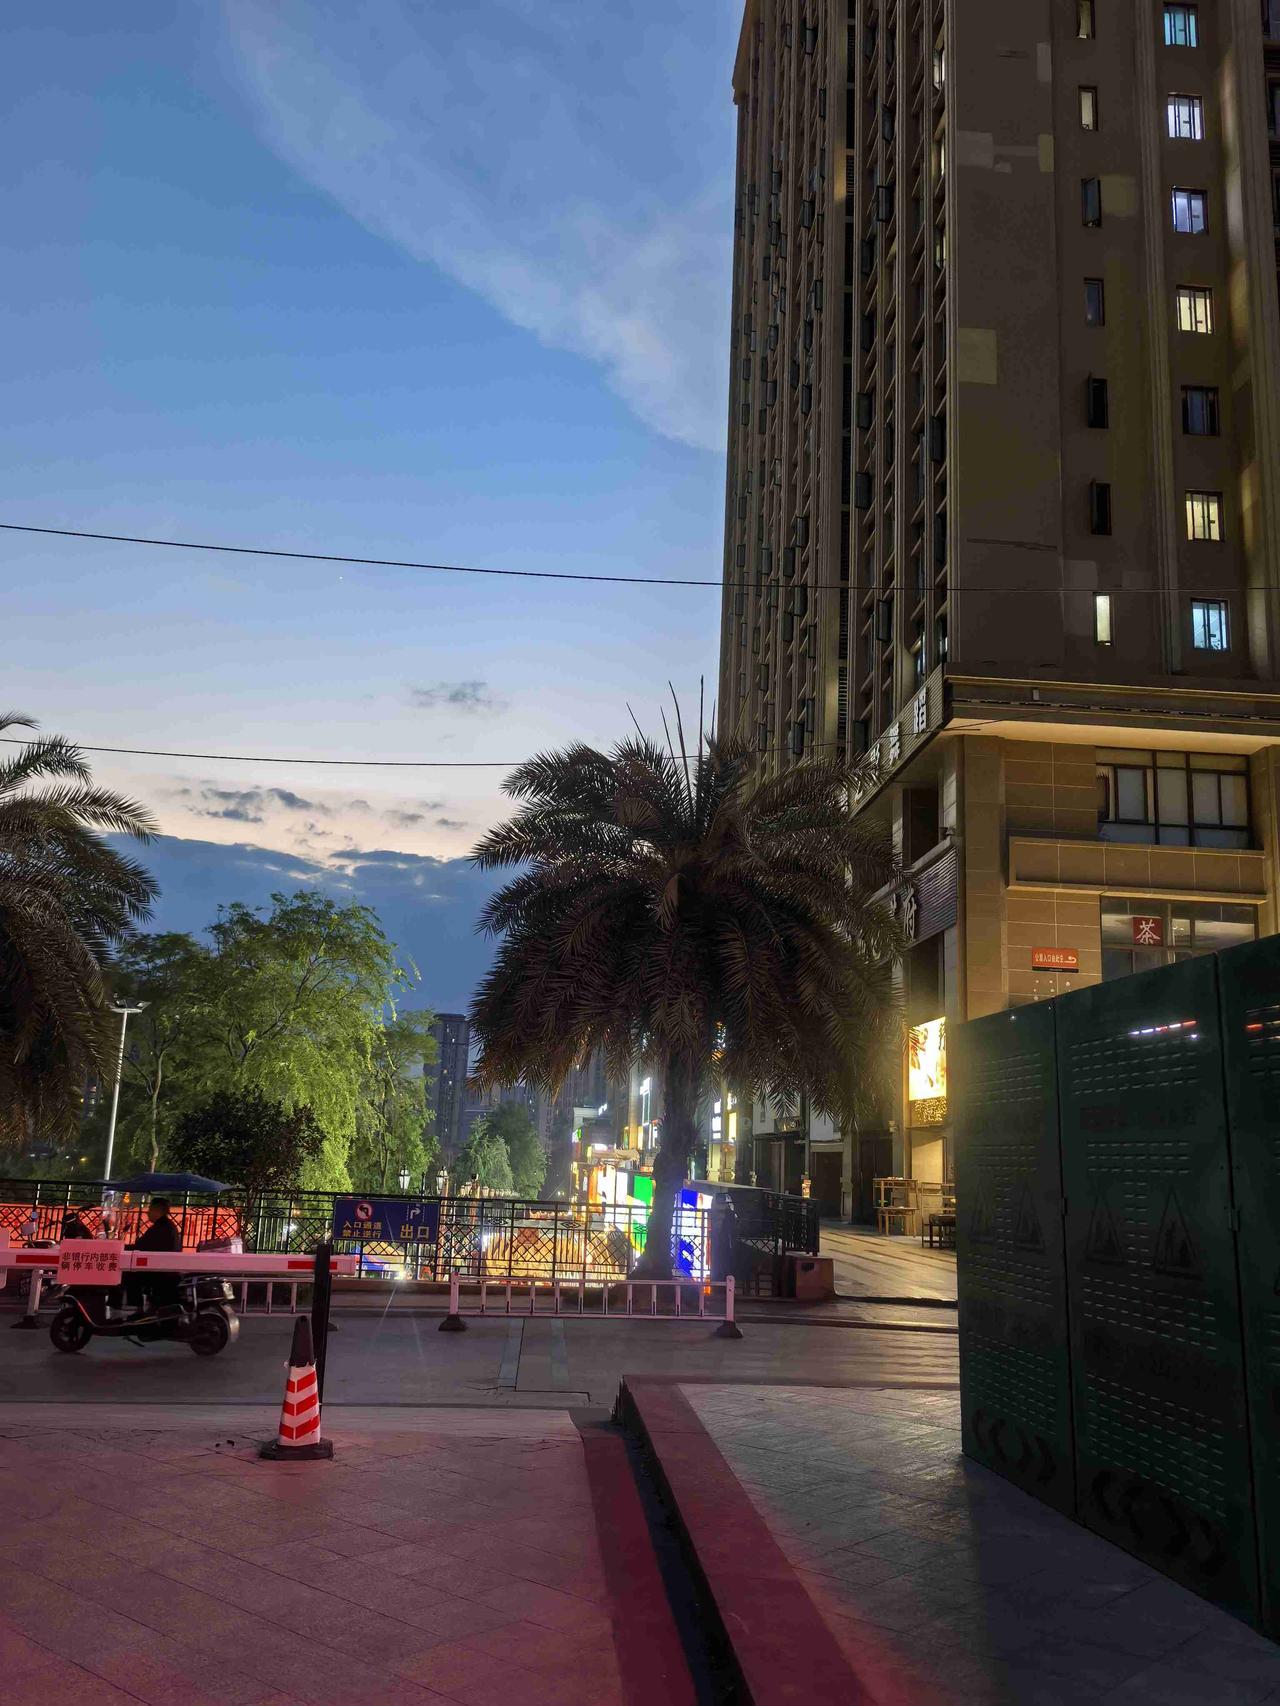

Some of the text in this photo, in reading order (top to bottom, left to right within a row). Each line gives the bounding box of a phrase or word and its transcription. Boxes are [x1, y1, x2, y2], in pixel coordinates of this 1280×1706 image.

[1136, 919, 1161, 945] 茶
[343, 1221, 382, 1230] 入口通道
[342, 1230, 382, 1239] 禁止逆行
[400, 1223, 430, 1239] 出口
[62, 1252, 118, 1262] 非银行内部车
[61, 1261, 118, 1272] 辆停车收费
